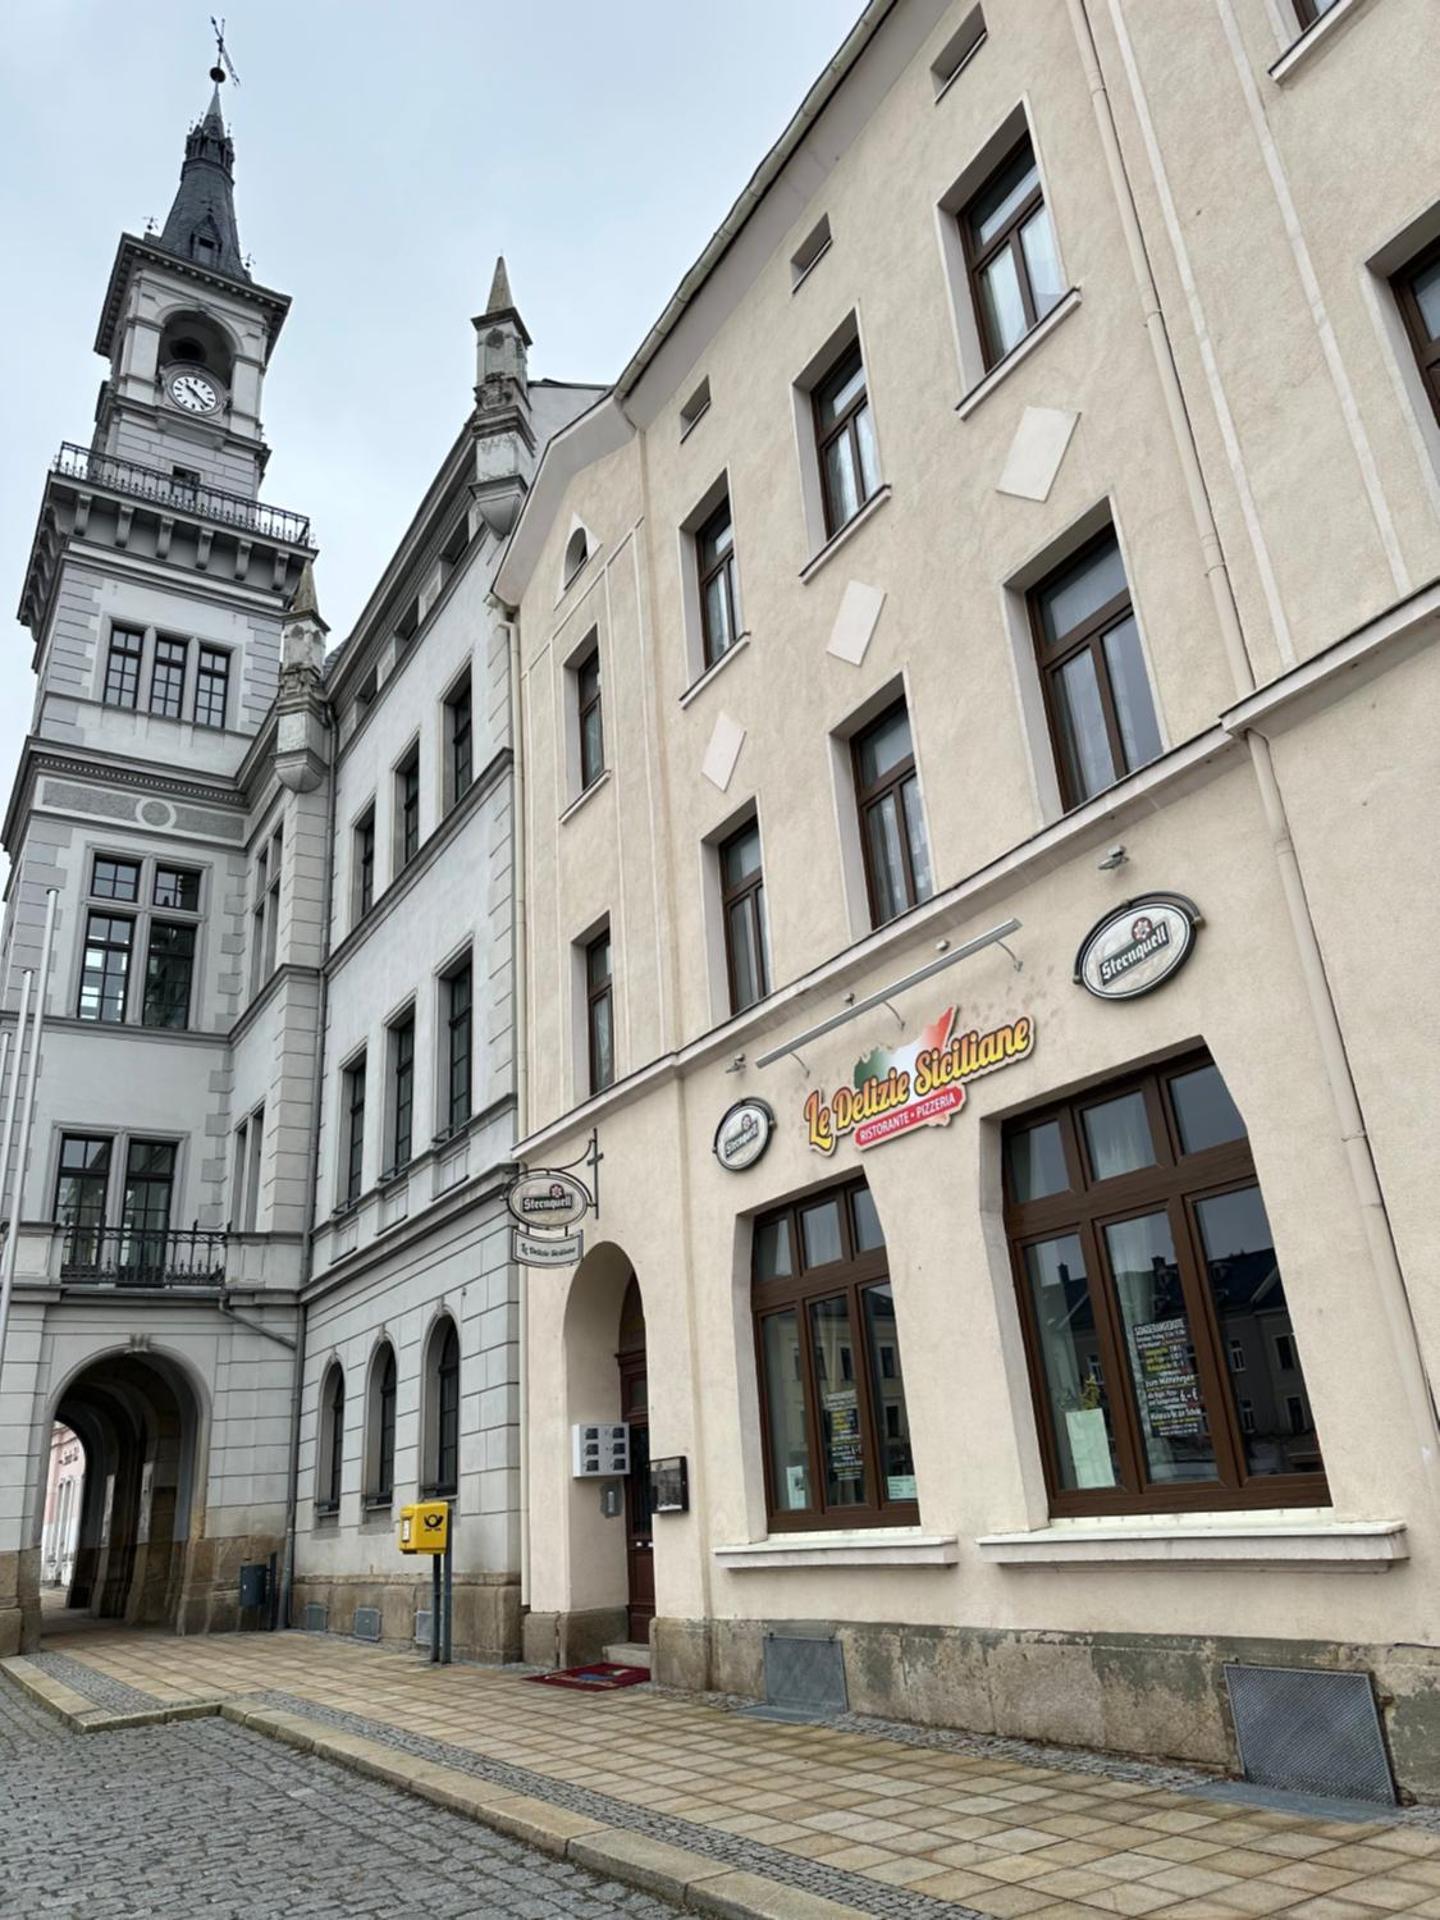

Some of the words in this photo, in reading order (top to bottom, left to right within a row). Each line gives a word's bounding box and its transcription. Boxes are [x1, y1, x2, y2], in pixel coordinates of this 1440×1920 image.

[1102, 924, 1167, 979] Sternquell
[804, 1089, 833, 1152] Le
[832, 1067, 911, 1130] Delizie
[914, 1016, 1031, 1097] Siciliane
[859, 1114, 910, 1143] RISTORANTE
[915, 1092, 956, 1120] PIZZERIA
[524, 1196, 571, 1211] Sternquell
